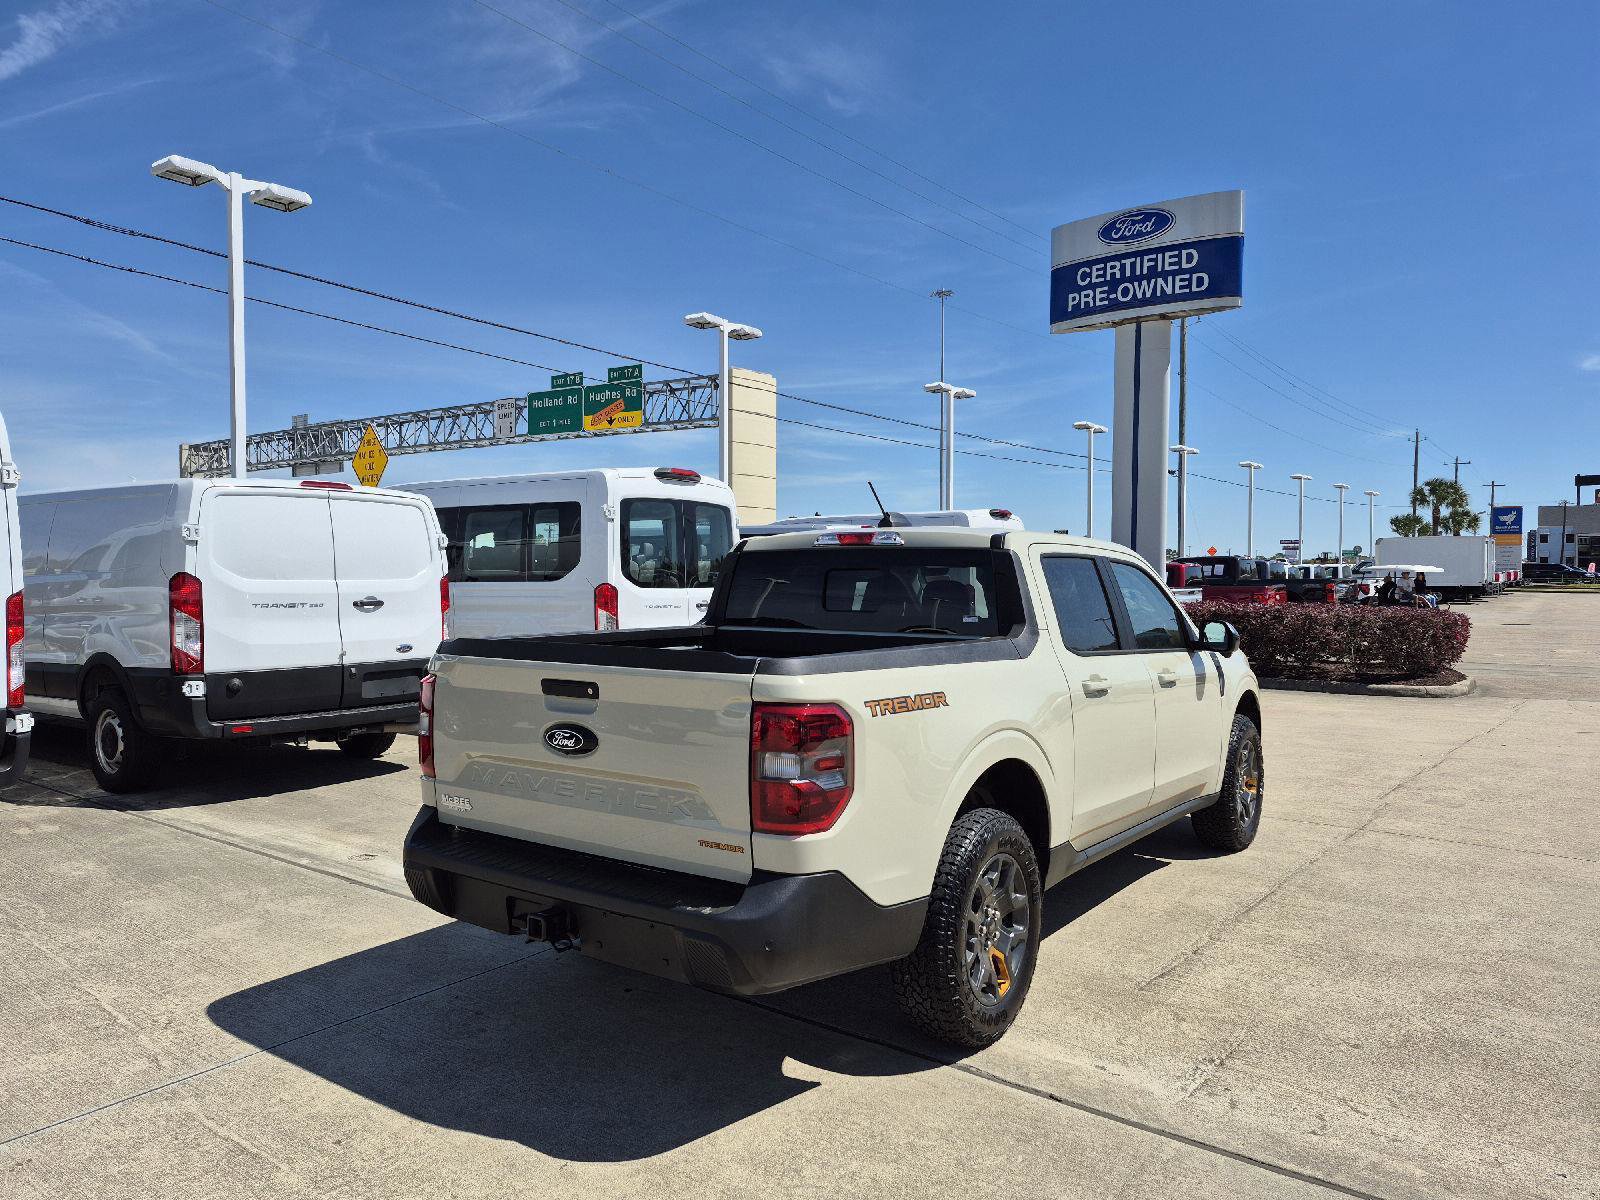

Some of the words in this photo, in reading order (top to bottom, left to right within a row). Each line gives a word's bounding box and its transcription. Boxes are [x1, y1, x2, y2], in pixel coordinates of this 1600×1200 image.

[1111, 214, 1157, 239] Ford
[1077, 248, 1199, 286] CERTIFIED
[1067, 272, 1210, 312] PRE-OWNED
[532, 396, 563, 408] Holland
[567, 394, 578, 405] Rd
[589, 389, 621, 402] Hughes
[625, 387, 637, 398] Rd
[497, 402, 515, 410] SPEED
[618, 415, 635, 424] ONLY
[863, 691, 950, 718] TREMOR
[552, 731, 576, 747] Ford
[471, 765, 694, 818] MAVERICK
[697, 839, 745, 854] TREMOR
